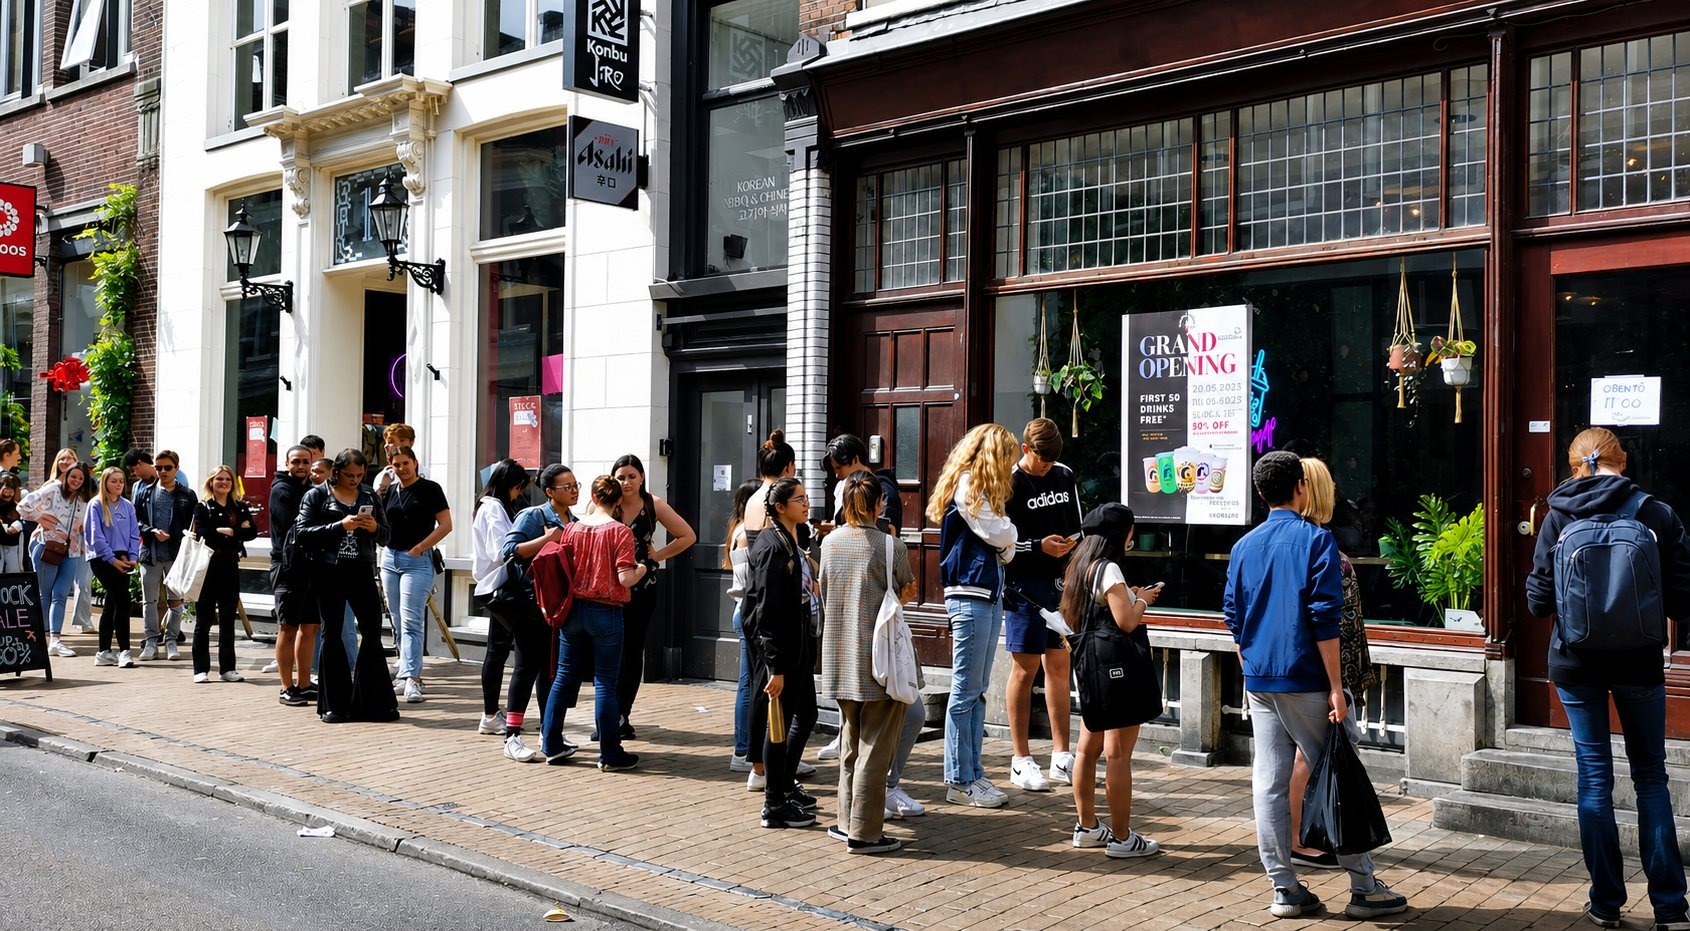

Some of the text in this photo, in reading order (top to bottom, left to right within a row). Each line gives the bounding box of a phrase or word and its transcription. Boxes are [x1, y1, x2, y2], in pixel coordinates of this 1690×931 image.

[587, 38, 628, 63] Konbu
[577, 140, 633, 174] Asahi
[597, 174, 616, 188] 辛口
[736, 176, 776, 192] KOREAN
[1139, 331, 1217, 357] GRAND
[1139, 353, 1236, 379] OPENING
[1139, 393, 1181, 403] FIRST 50
[1139, 403, 1175, 414] DRINKS
[1213, 420, 1230, 430] OFF
[1027, 490, 1070, 510] adidas
